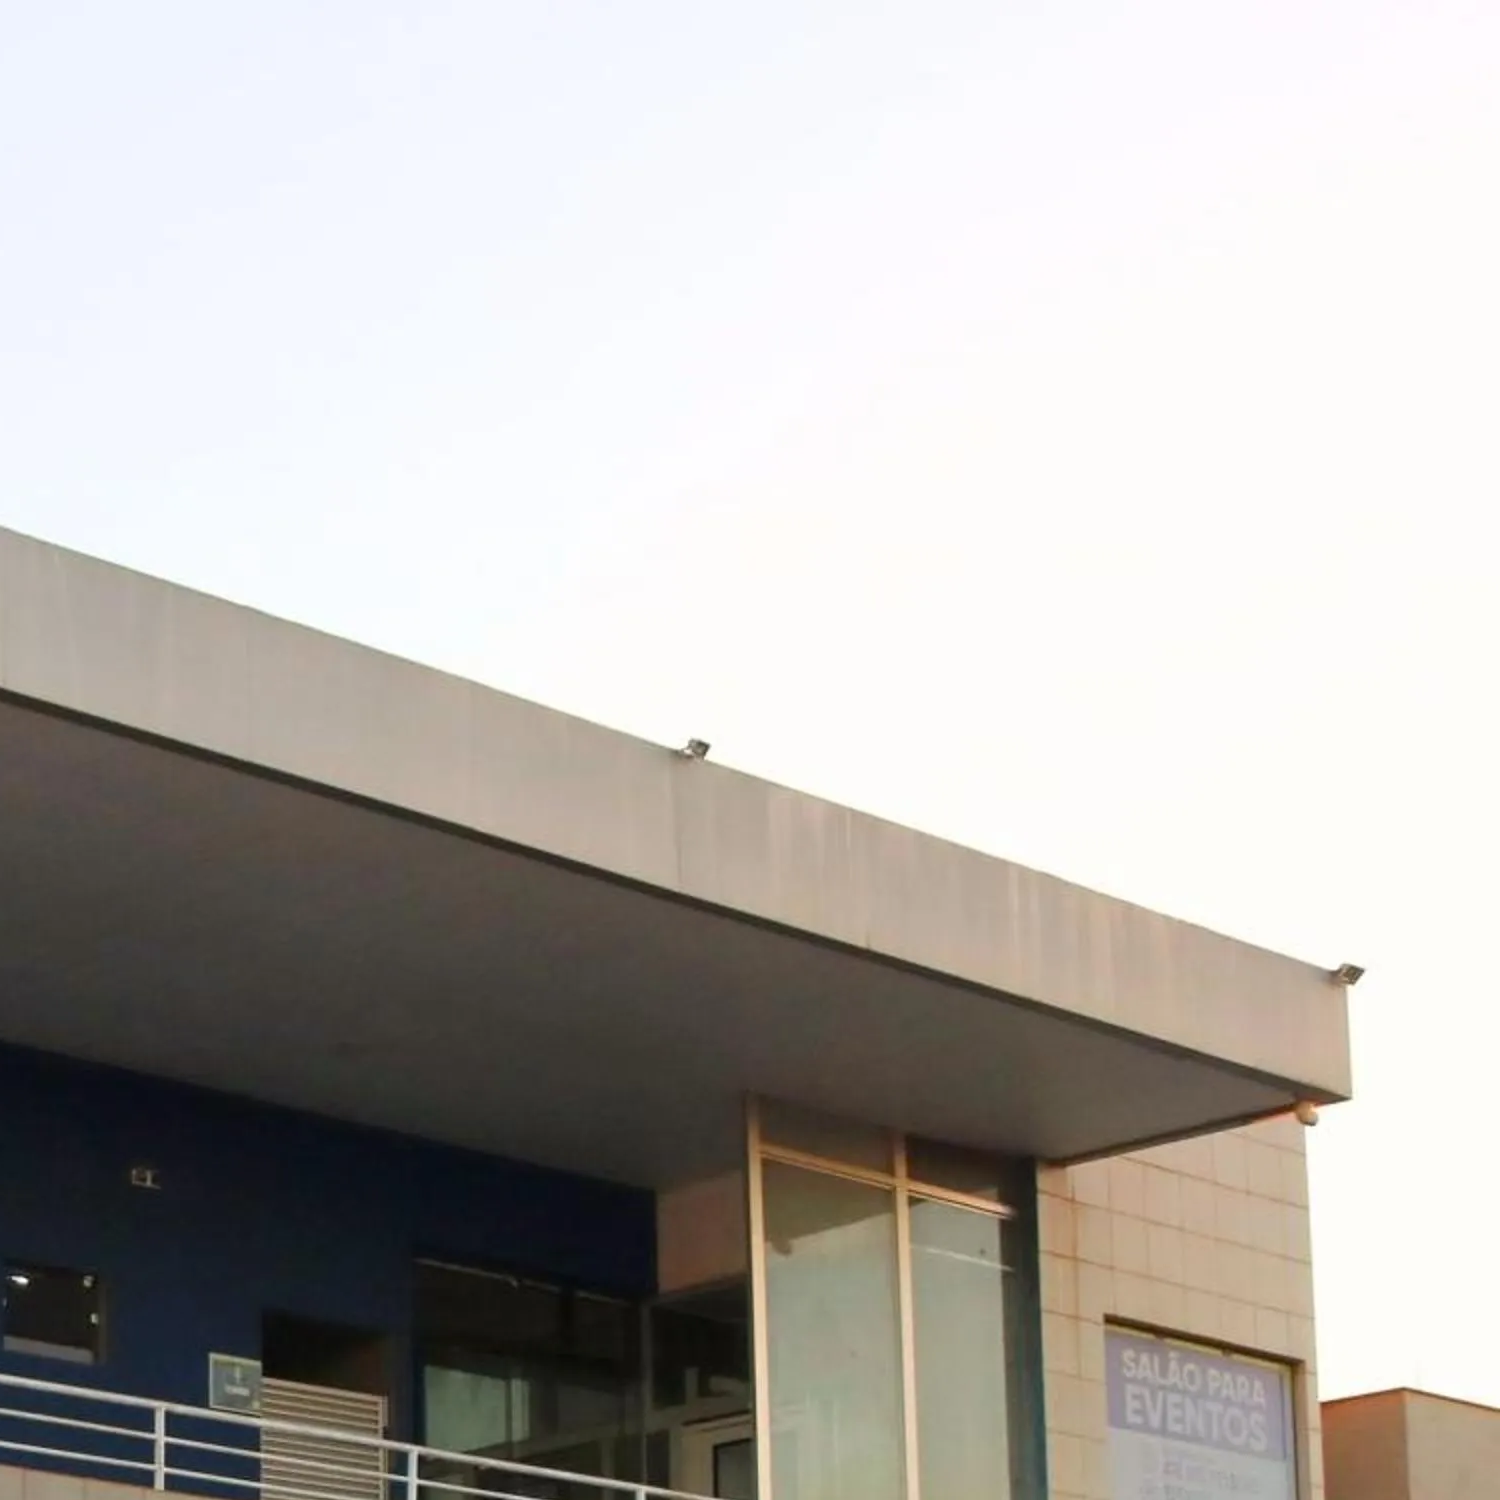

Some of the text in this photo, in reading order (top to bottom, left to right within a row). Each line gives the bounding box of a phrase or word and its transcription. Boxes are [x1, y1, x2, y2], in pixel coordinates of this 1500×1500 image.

[1121, 1349, 1266, 1409] SALÃO PARA
[1124, 1383, 1268, 1452] EVENTOS
